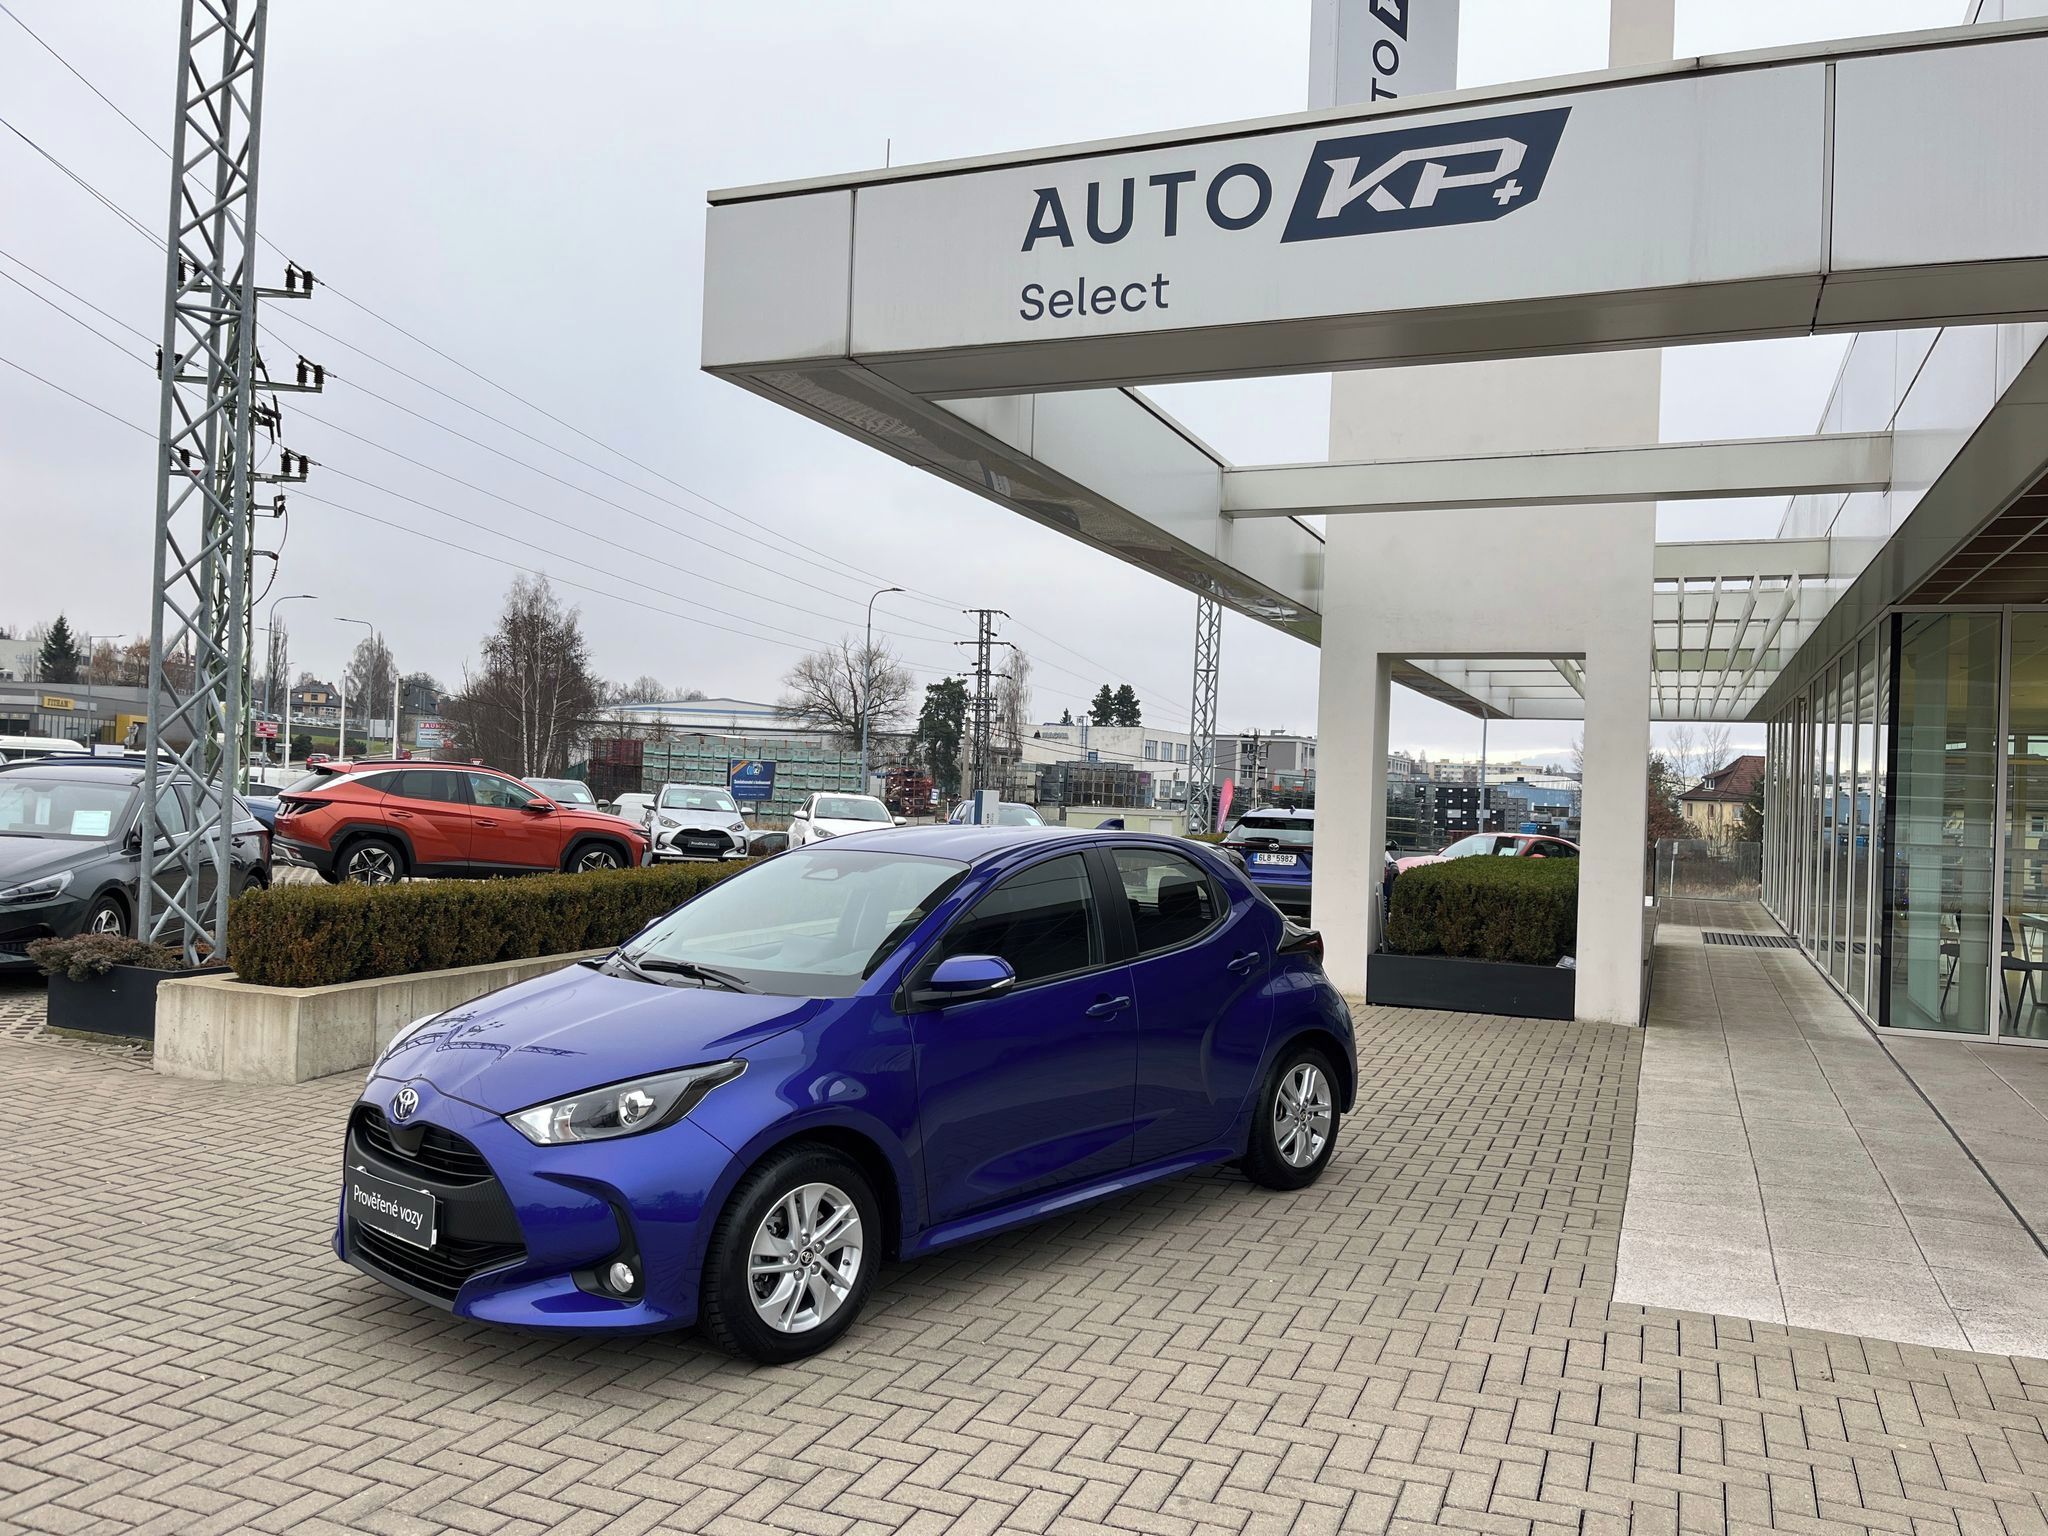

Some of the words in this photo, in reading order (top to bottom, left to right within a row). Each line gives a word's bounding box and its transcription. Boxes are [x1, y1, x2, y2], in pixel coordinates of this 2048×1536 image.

[1020, 162, 1272, 252] AUTO
[1019, 272, 1170, 321] Select
[1258, 853, 1272, 862] 6L8
[1276, 854, 1294, 863] 5982
[353, 1184, 399, 1218] Prověřené
[399, 1206, 424, 1231] vozy
